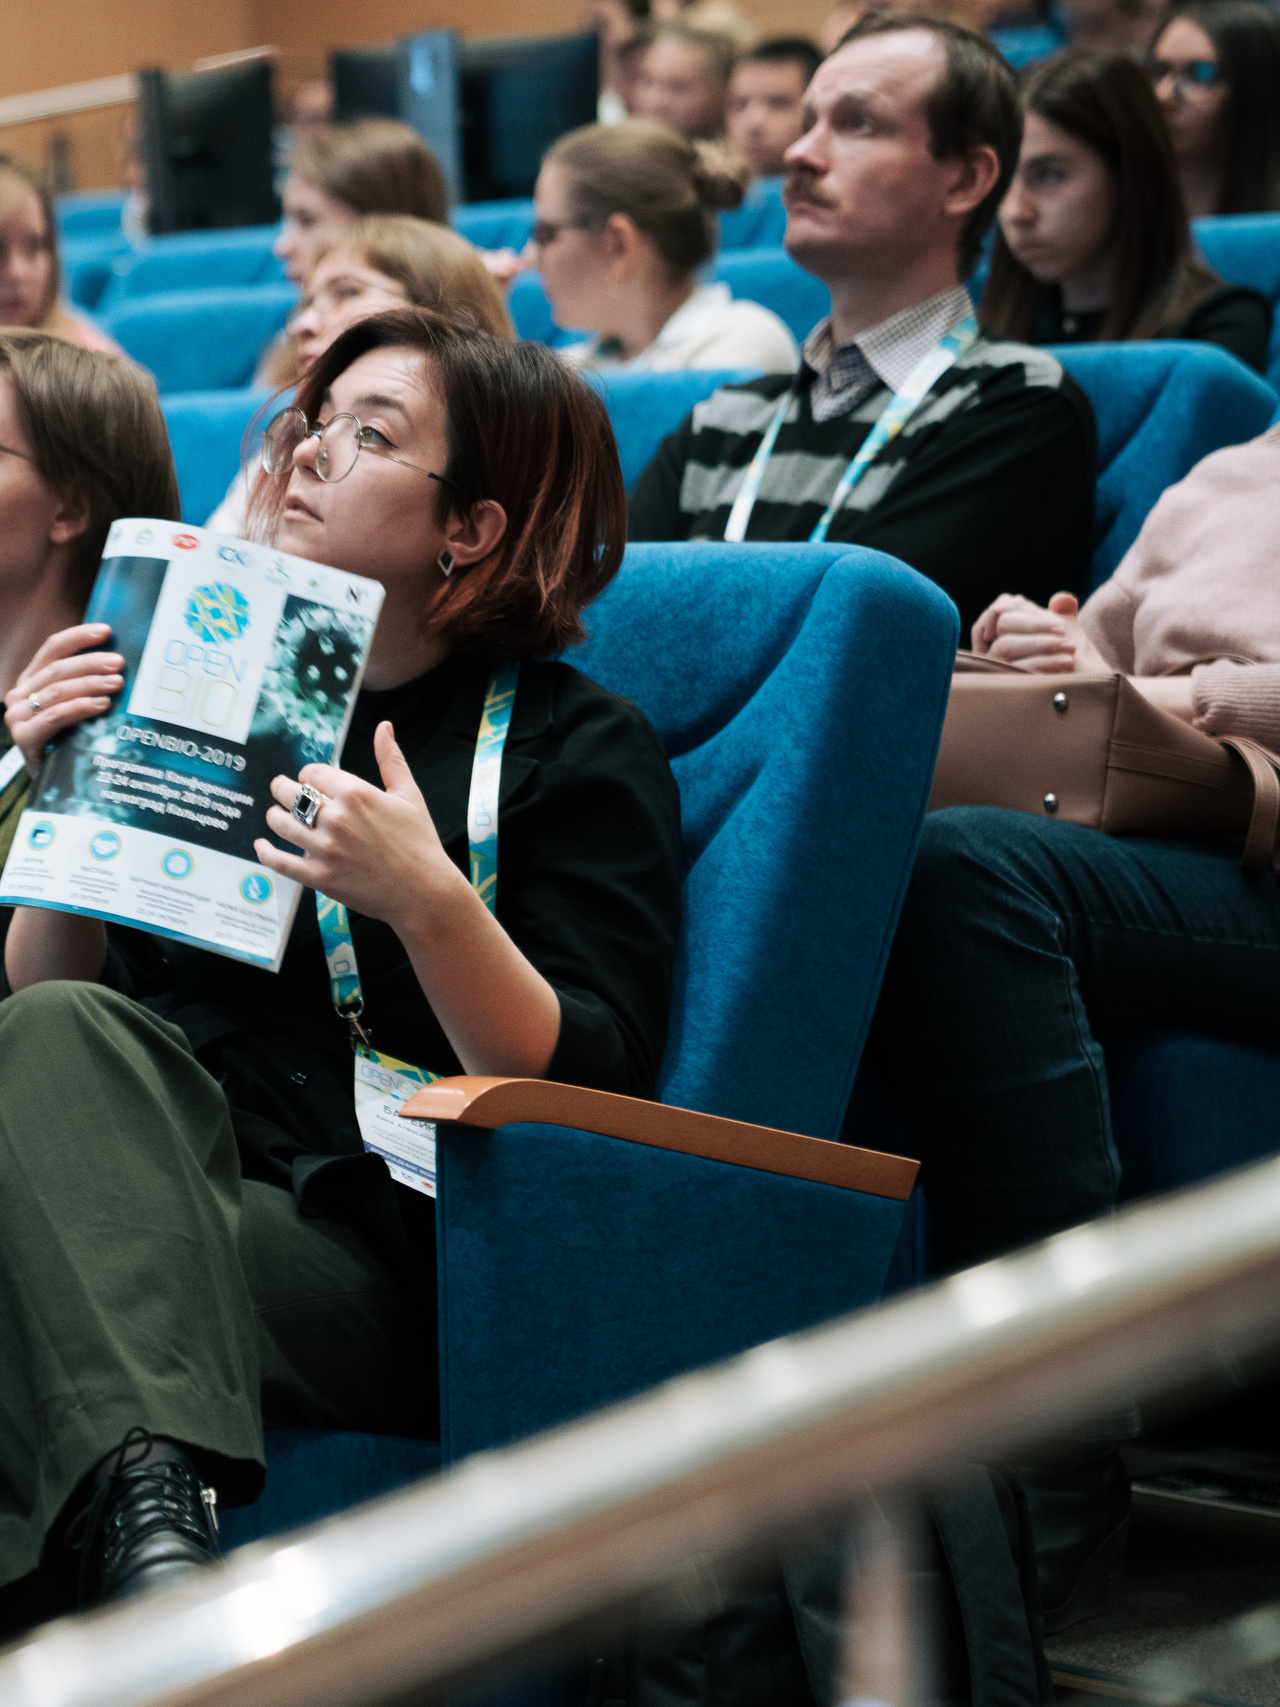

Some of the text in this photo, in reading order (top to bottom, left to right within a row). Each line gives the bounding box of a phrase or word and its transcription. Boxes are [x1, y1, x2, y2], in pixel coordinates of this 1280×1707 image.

[163, 639, 248, 683] OPEN
[151, 665, 238, 728] BIO
[116, 725, 246, 772] OPENBIO-2019
[92, 755, 254, 807] Программа Конференции
[128, 779, 181, 800] октября
[181, 790, 212, 809] 2019
[210, 801, 242, 820] года
